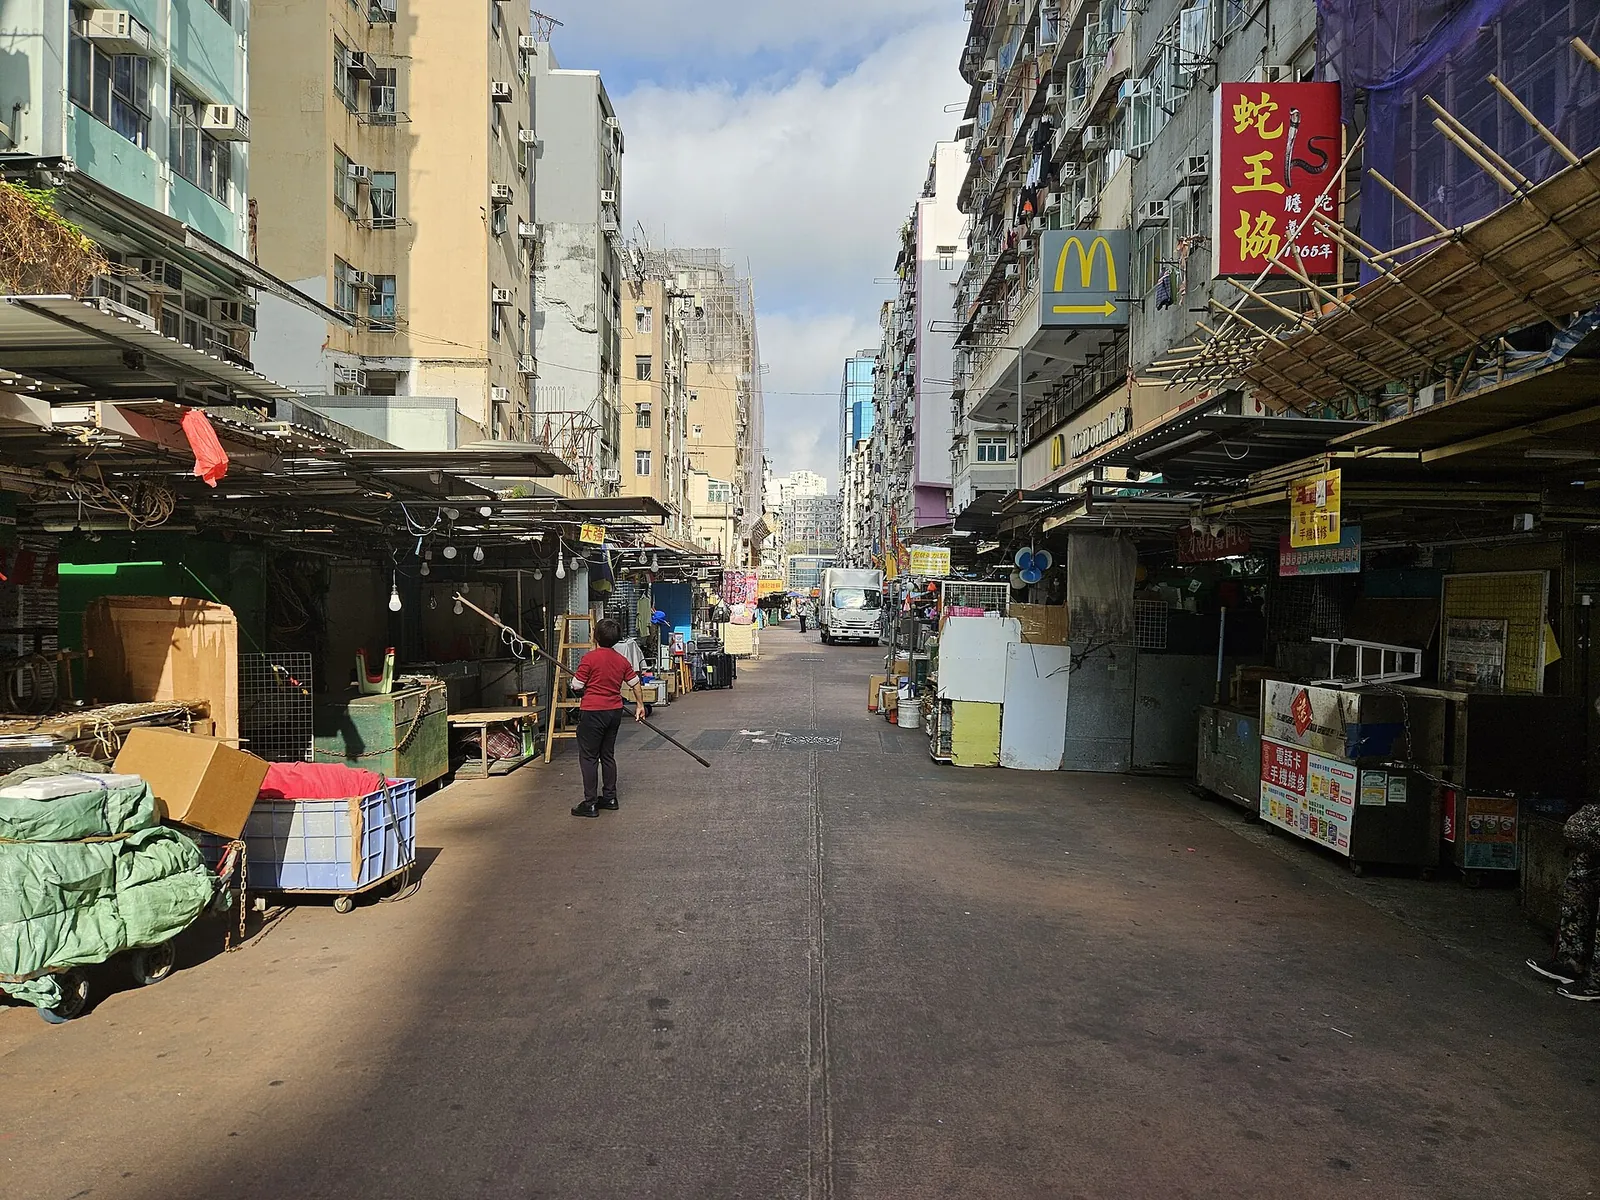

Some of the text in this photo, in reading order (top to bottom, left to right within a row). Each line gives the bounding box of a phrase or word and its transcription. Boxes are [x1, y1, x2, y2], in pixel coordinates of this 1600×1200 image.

[1231, 91, 1285, 263] 蛇王協
[1070, 406, 1126, 459] McDonald's
[583, 525, 604, 543] 大強
[1299, 526, 1328, 542] 手機維修
[1276, 746, 1301, 770] 電話卡
[1270, 765, 1305, 792] 手機維修
